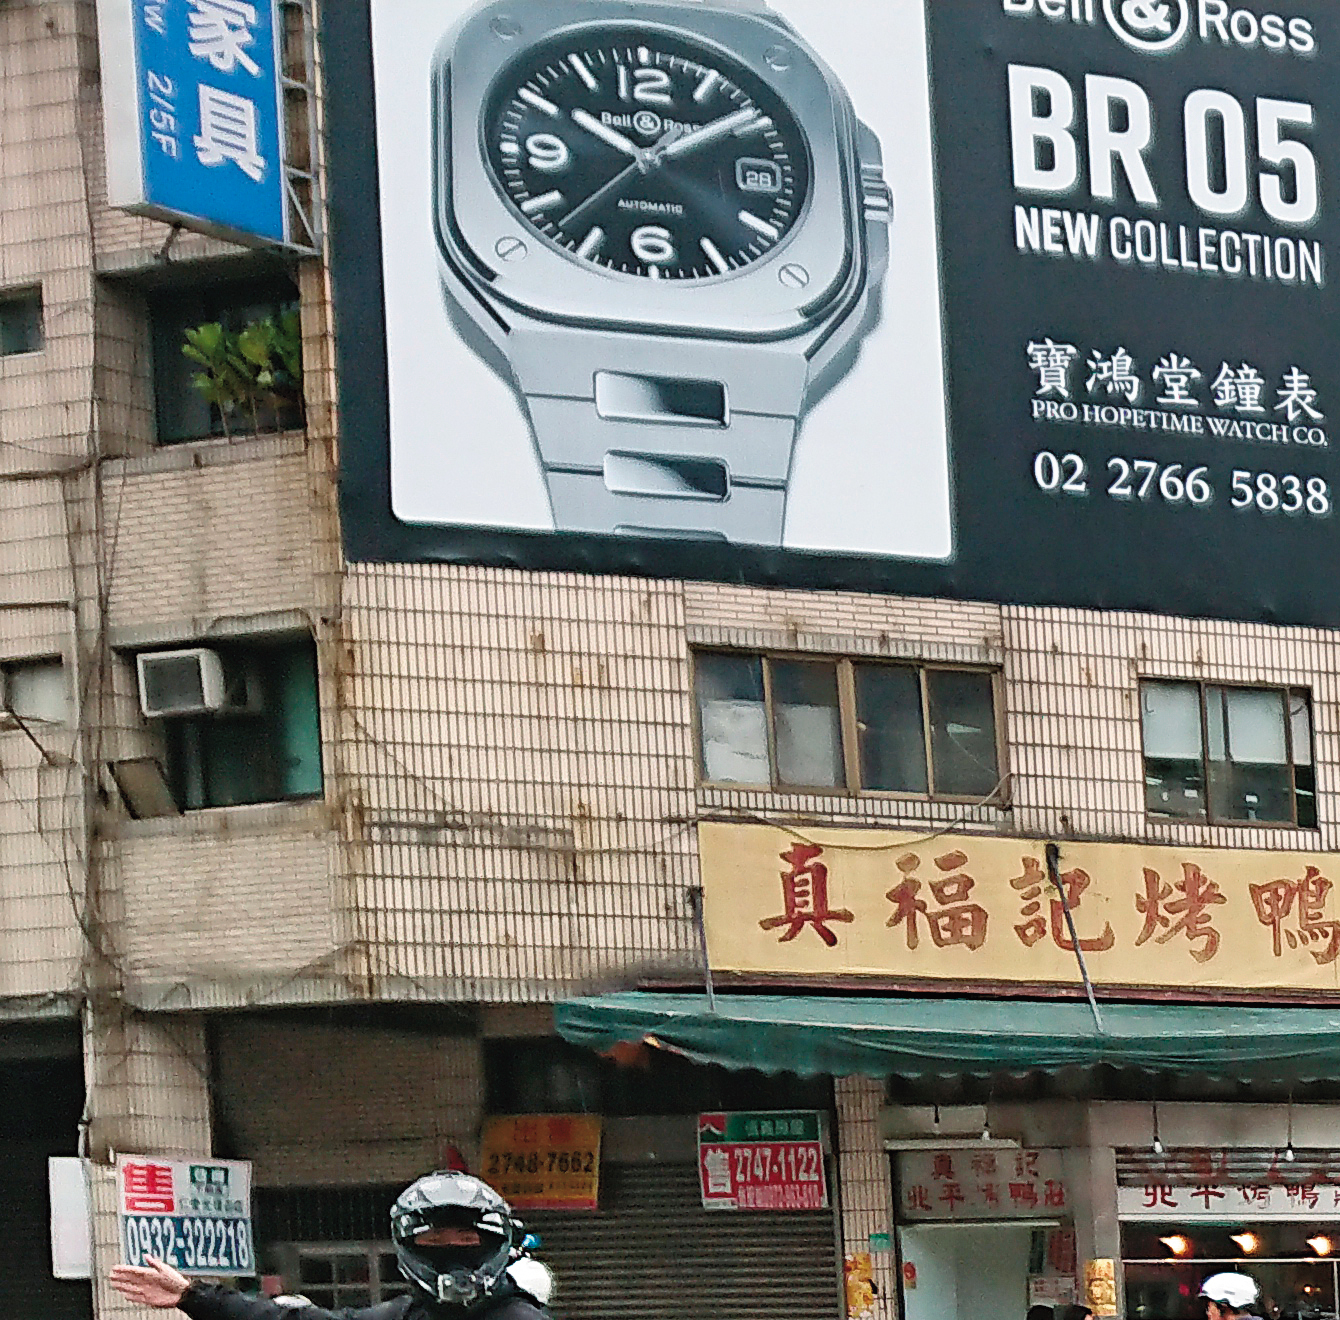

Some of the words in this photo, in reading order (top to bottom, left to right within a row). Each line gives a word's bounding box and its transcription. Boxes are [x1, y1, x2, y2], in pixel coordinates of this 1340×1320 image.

[1200, 0, 1315, 53] Ross
[618, 64, 672, 104] 12
[147, 70, 177, 158] 2/5F
[526, 133, 569, 169] 9
[1007, 63, 1159, 205] BR
[1183, 88, 1318, 224] 05
[631, 225, 675, 262] 6
[1014, 204, 1099, 257] NEW
[1109, 216, 1322, 285] COLLECTION
[1027, 336, 1325, 422] 寶鴻堂鐘表
[1031, 399, 1079, 421] PRO
[1083, 404, 1204, 434] HOPETIME
[1206, 415, 1290, 444] WATCH
[1292, 426, 1328, 447] CO.
[1034, 451, 1087, 492] 02
[1107, 457, 1210, 503] 2766
[1231, 469, 1330, 514] 5838
